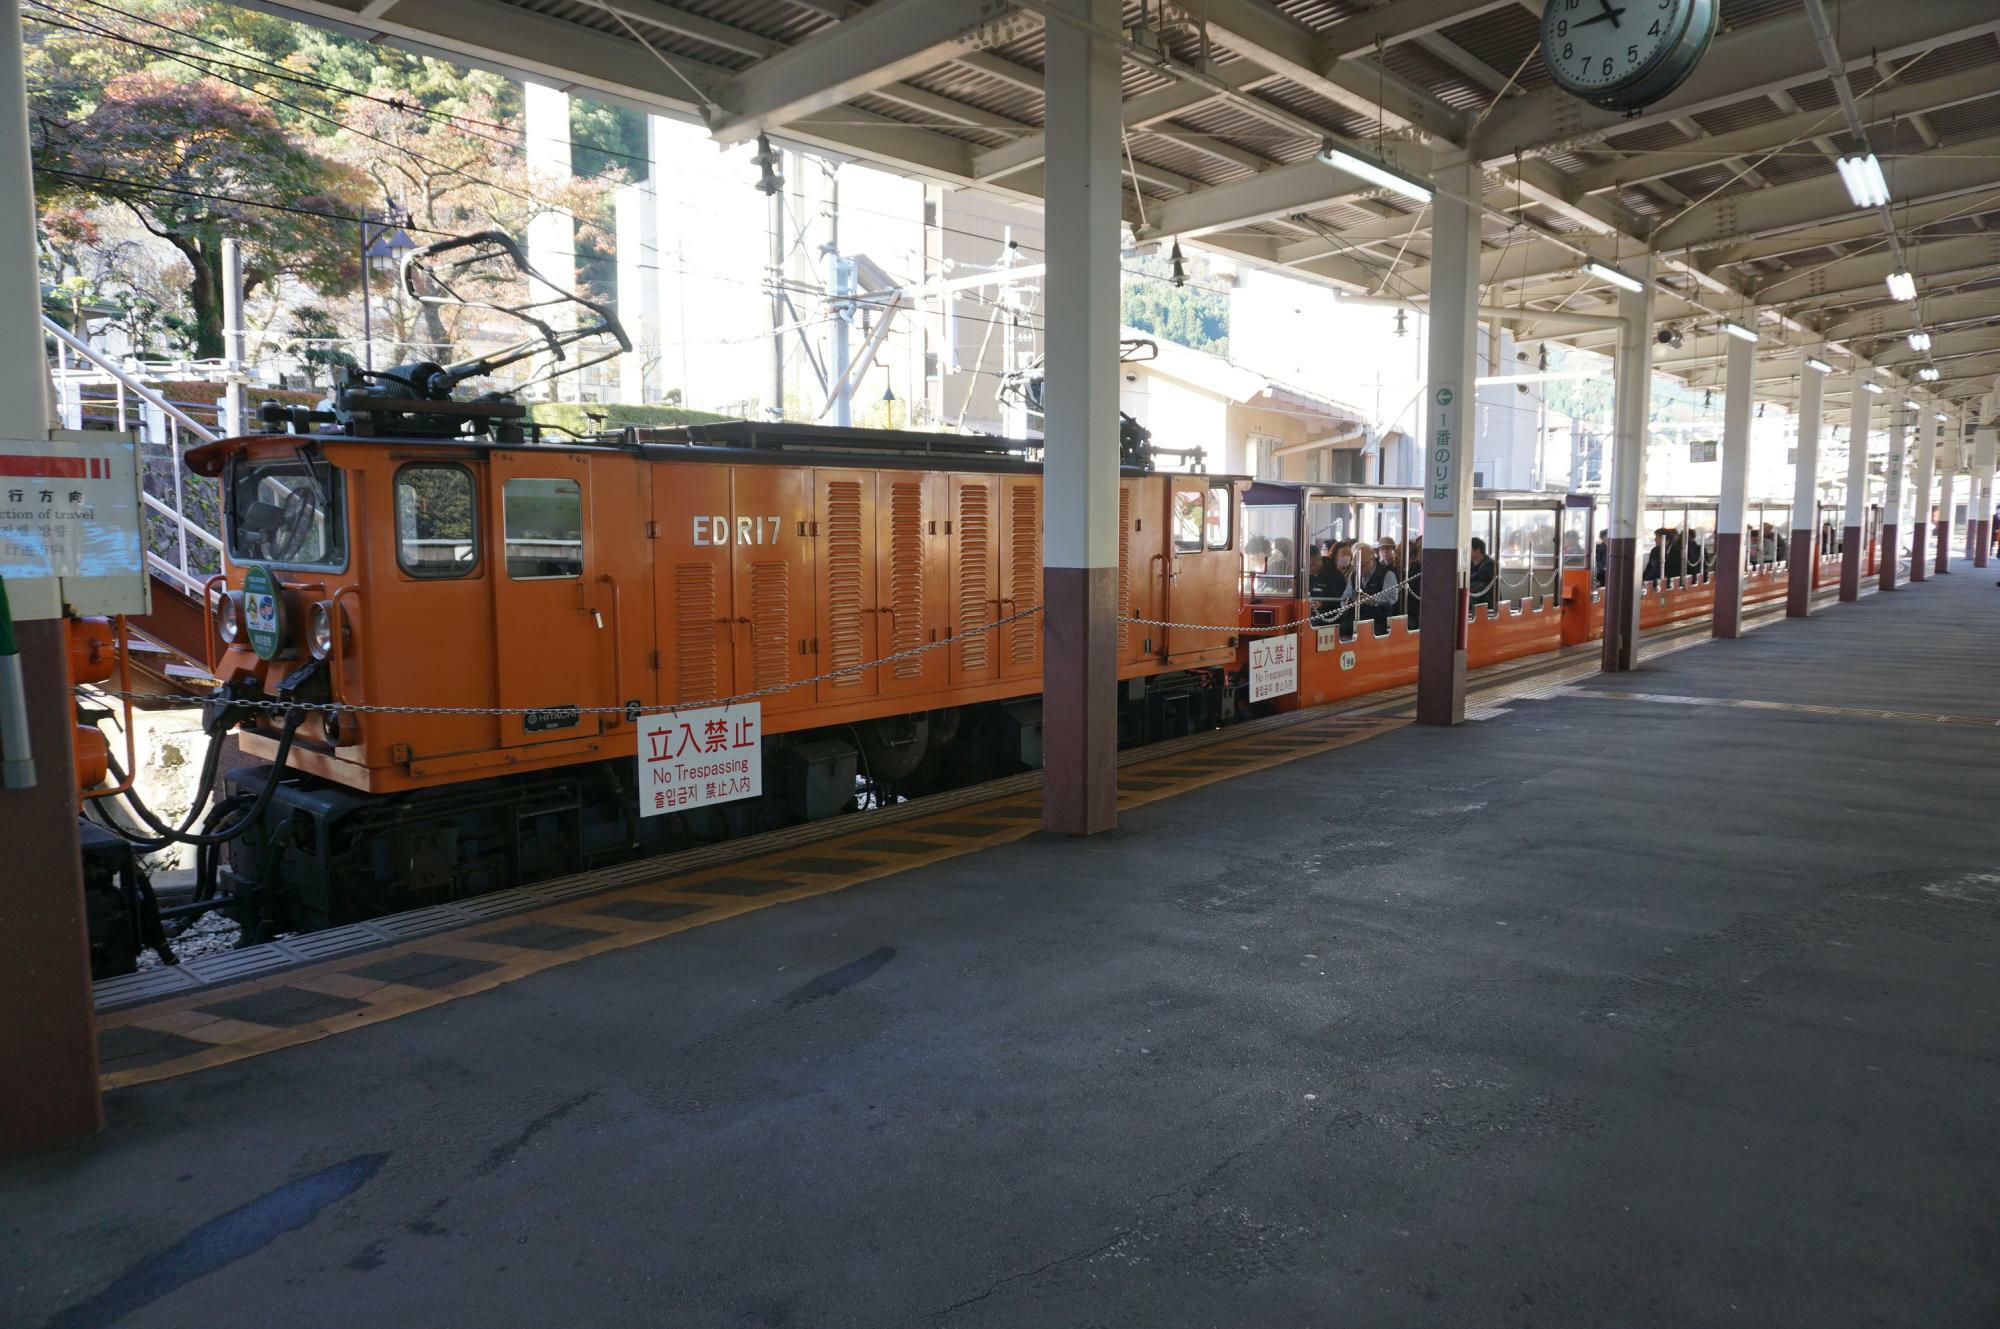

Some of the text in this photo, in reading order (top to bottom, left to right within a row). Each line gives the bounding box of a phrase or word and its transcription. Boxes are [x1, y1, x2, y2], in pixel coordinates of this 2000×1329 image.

[1557, 19, 1567, 38] 9
[1647, 19, 1661, 37] 4
[1562, 42, 1573, 60] 8
[1627, 45, 1639, 63] 5
[1582, 56, 1592, 75] 7
[1602, 57, 1613, 76] 6
[1434, 413, 1451, 500] 1番のりば
[38, 508, 51, 520] of
[55, 508, 95, 520] travel
[1253, 643, 1295, 669] 立入禁止
[628, 701, 641, 721] 2
[647, 716, 755, 763] 立入禁止
[653, 759, 749, 785] No Trespassing
[654, 776, 750, 809] 출입금지 禁止入内
